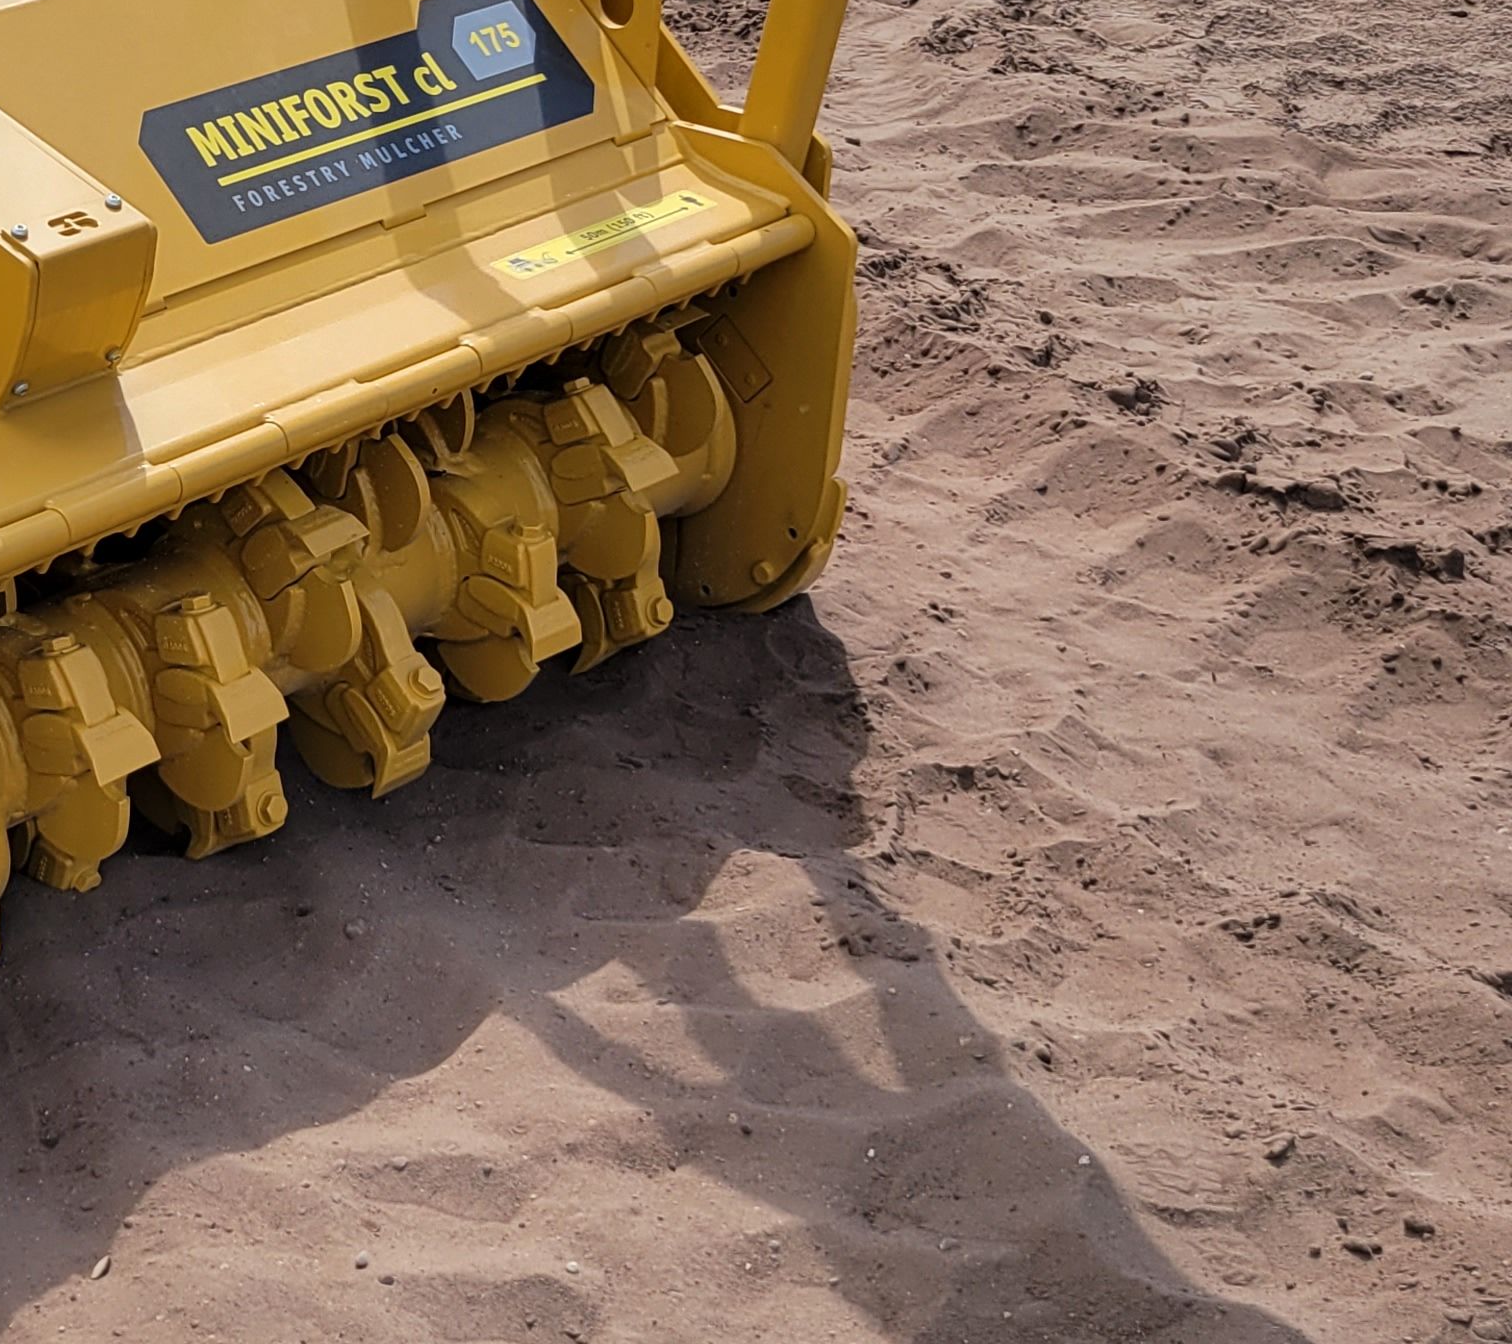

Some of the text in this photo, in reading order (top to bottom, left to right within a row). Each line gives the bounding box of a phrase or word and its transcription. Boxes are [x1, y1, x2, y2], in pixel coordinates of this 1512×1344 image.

[468, 22, 521, 57] 175
[185, 51, 458, 168] MINIFORST cl
[231, 123, 464, 212] FORESTRY MULCHER
[579, 227, 607, 242] 50m
